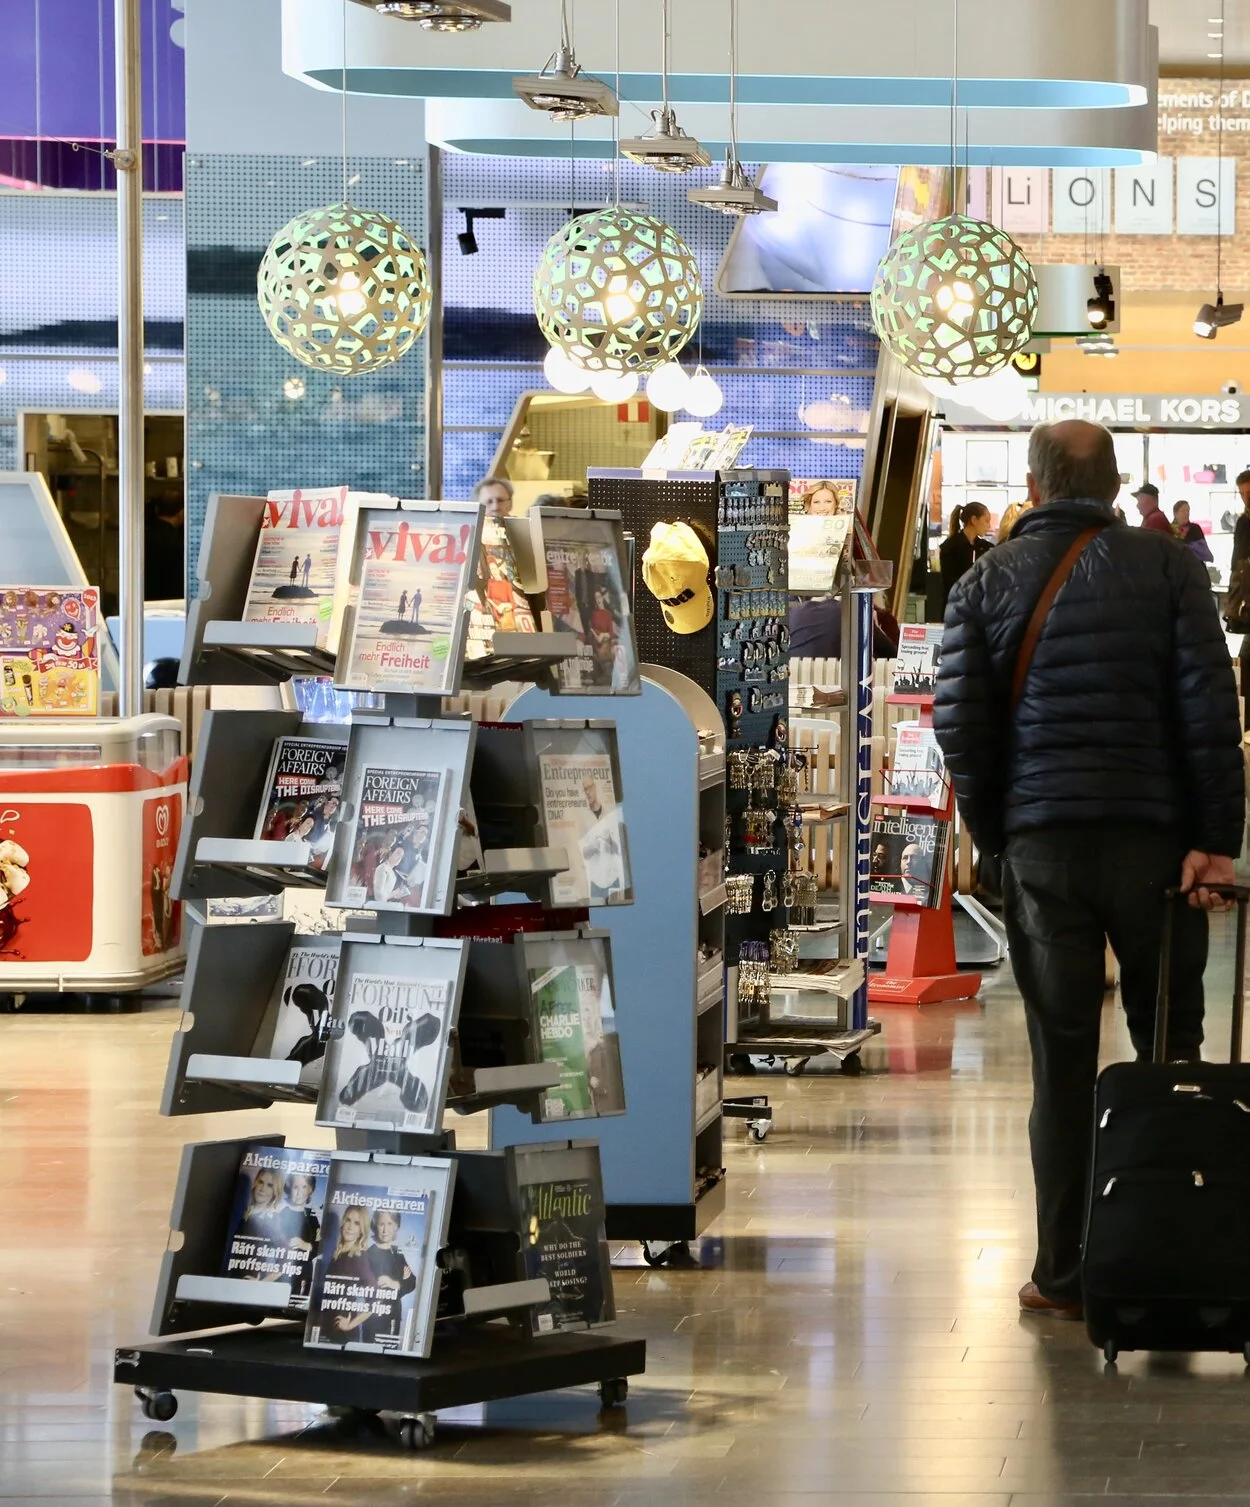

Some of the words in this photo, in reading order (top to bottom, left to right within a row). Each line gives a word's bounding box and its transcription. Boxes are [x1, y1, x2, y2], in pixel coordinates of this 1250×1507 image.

[1218, 90, 1238, 108] of
[1022, 397, 1151, 422] MICHAEL
[1160, 398, 1241, 424] KORS
[266, 486, 348, 529] viva!
[369, 522, 472, 564] viva!
[267, 606, 295, 617] Endlich
[376, 641, 405, 653] Endlich
[67, 661, 77, 669] 50
[359, 651, 380, 661] mehr
[380, 652, 431, 669] Freiheit
[280, 748, 335, 764] FOREIGN
[278, 761, 326, 776] AFFAIRS
[278, 777, 298, 785] HERE
[365, 775, 420, 791] FOREIGN
[276, 785, 298, 798] THE
[362, 788, 412, 804] AFFAIRS
[545, 787, 555, 798] Do
[566, 788, 580, 798] have
[364, 805, 385, 814] HERE
[547, 810, 564, 820] DNA?
[362, 814, 386, 827] THE
[872, 816, 939, 843] intelligent
[918, 834, 936, 857] life
[379, 1005, 414, 1024] Oil's
[540, 1013, 581, 1027] CHARLIE
[541, 1026, 573, 1040] HEBDO
[332, 1190, 425, 1211] Aktiespararen
[534, 1183, 592, 1221] Atlantic
[231, 1241, 256, 1255] Rätt
[256, 1244, 286, 1259] skatt
[286, 1249, 310, 1262] med
[543, 1243, 558, 1252] WHY
[559, 1242, 568, 1250] DO
[568, 1240, 582, 1249] THE
[556, 1249, 587, 1260] SOLDIERS
[228, 1257, 280, 1272] proffsens
[281, 1263, 303, 1277] tips
[323, 1280, 345, 1295] Rätt
[346, 1284, 375, 1299] skatt
[375, 1287, 399, 1300] med
[321, 1298, 369, 1312] proffsens
[371, 1302, 392, 1316] tips
